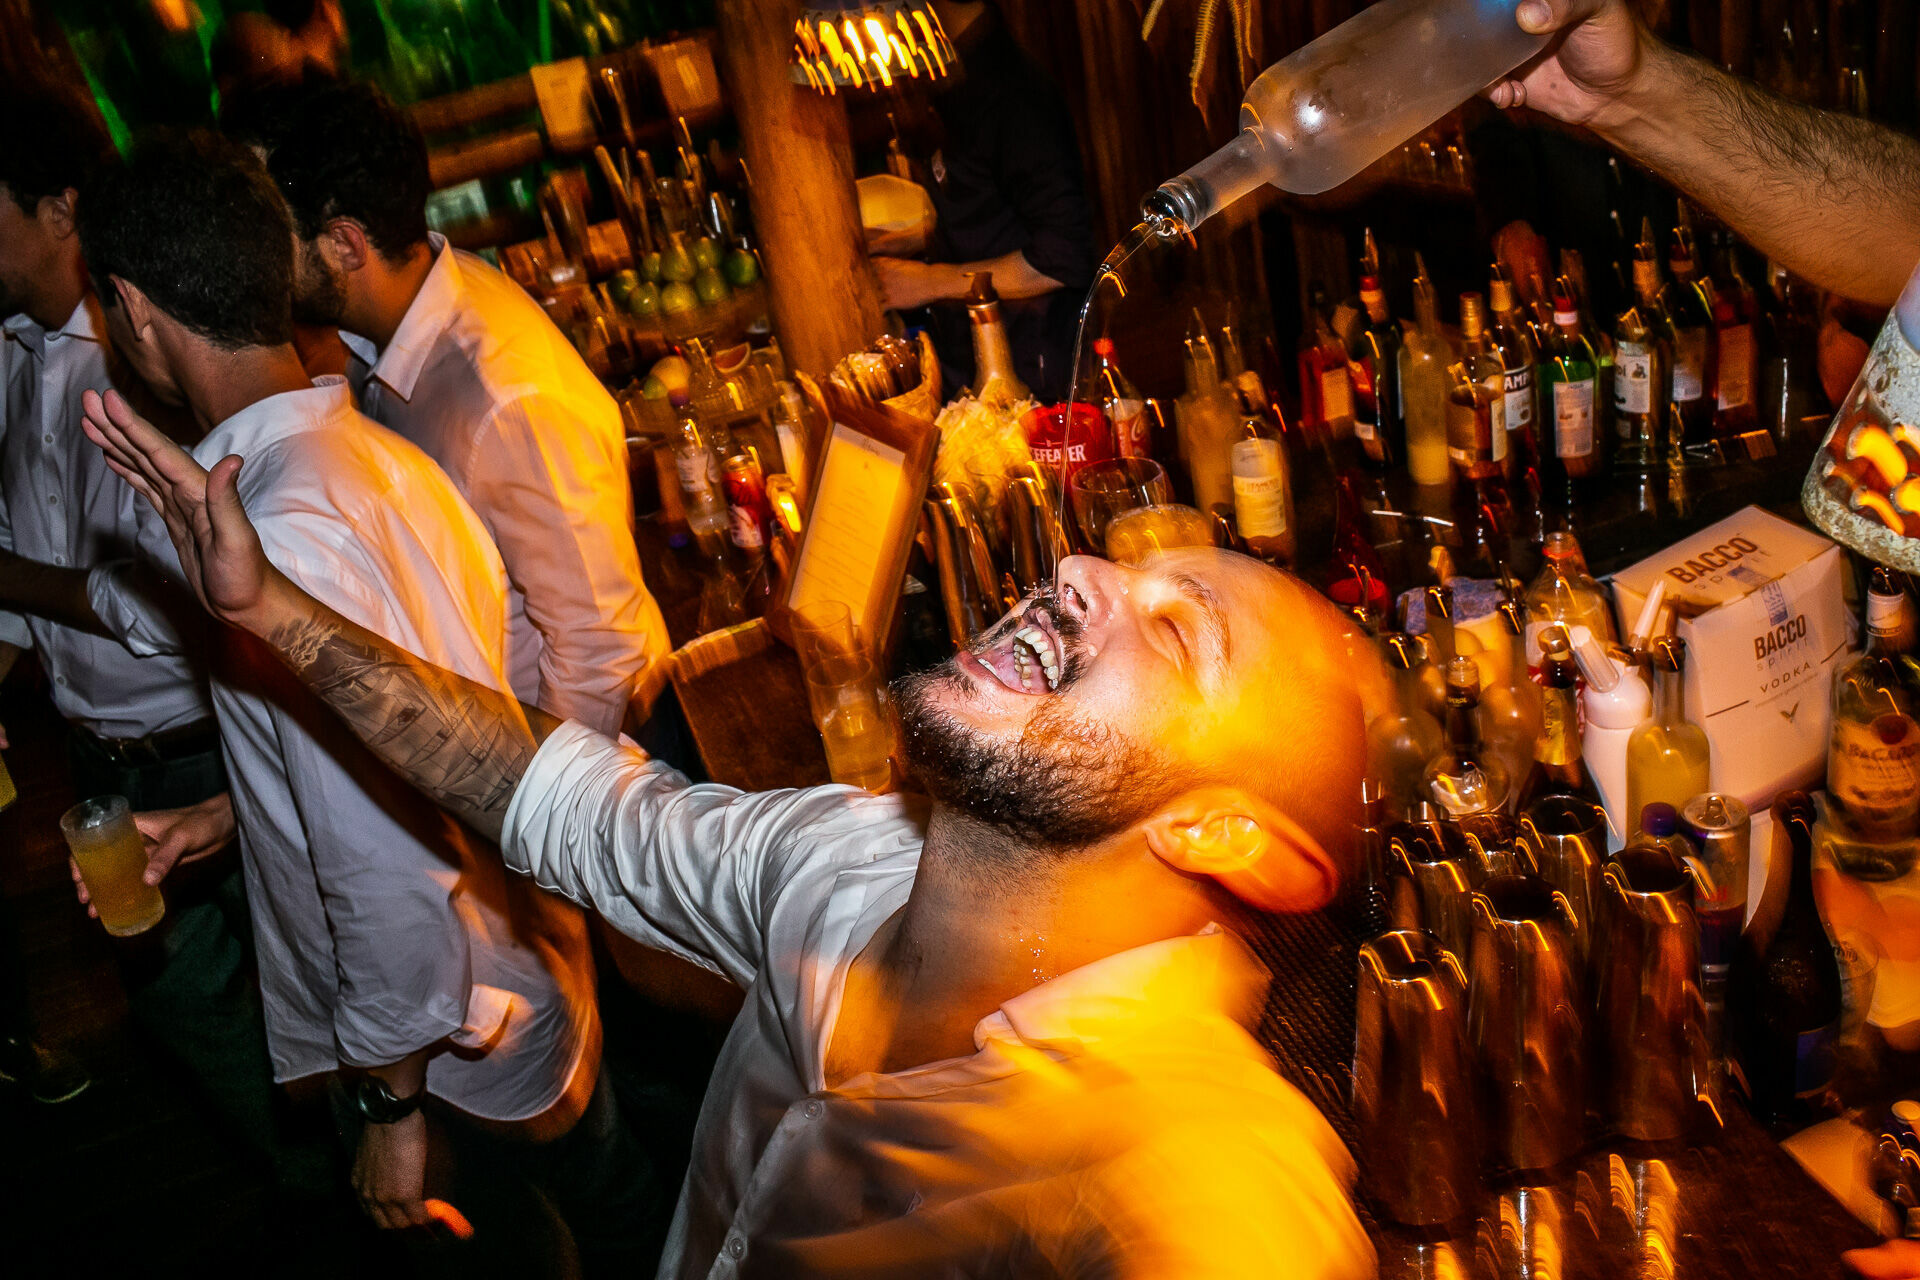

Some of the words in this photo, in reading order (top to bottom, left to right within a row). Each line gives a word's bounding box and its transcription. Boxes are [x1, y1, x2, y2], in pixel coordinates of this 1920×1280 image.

[1666, 537, 1758, 584] BACCO
[1754, 614, 1806, 660] BACCO
[1760, 661, 1810, 693] VODKA
